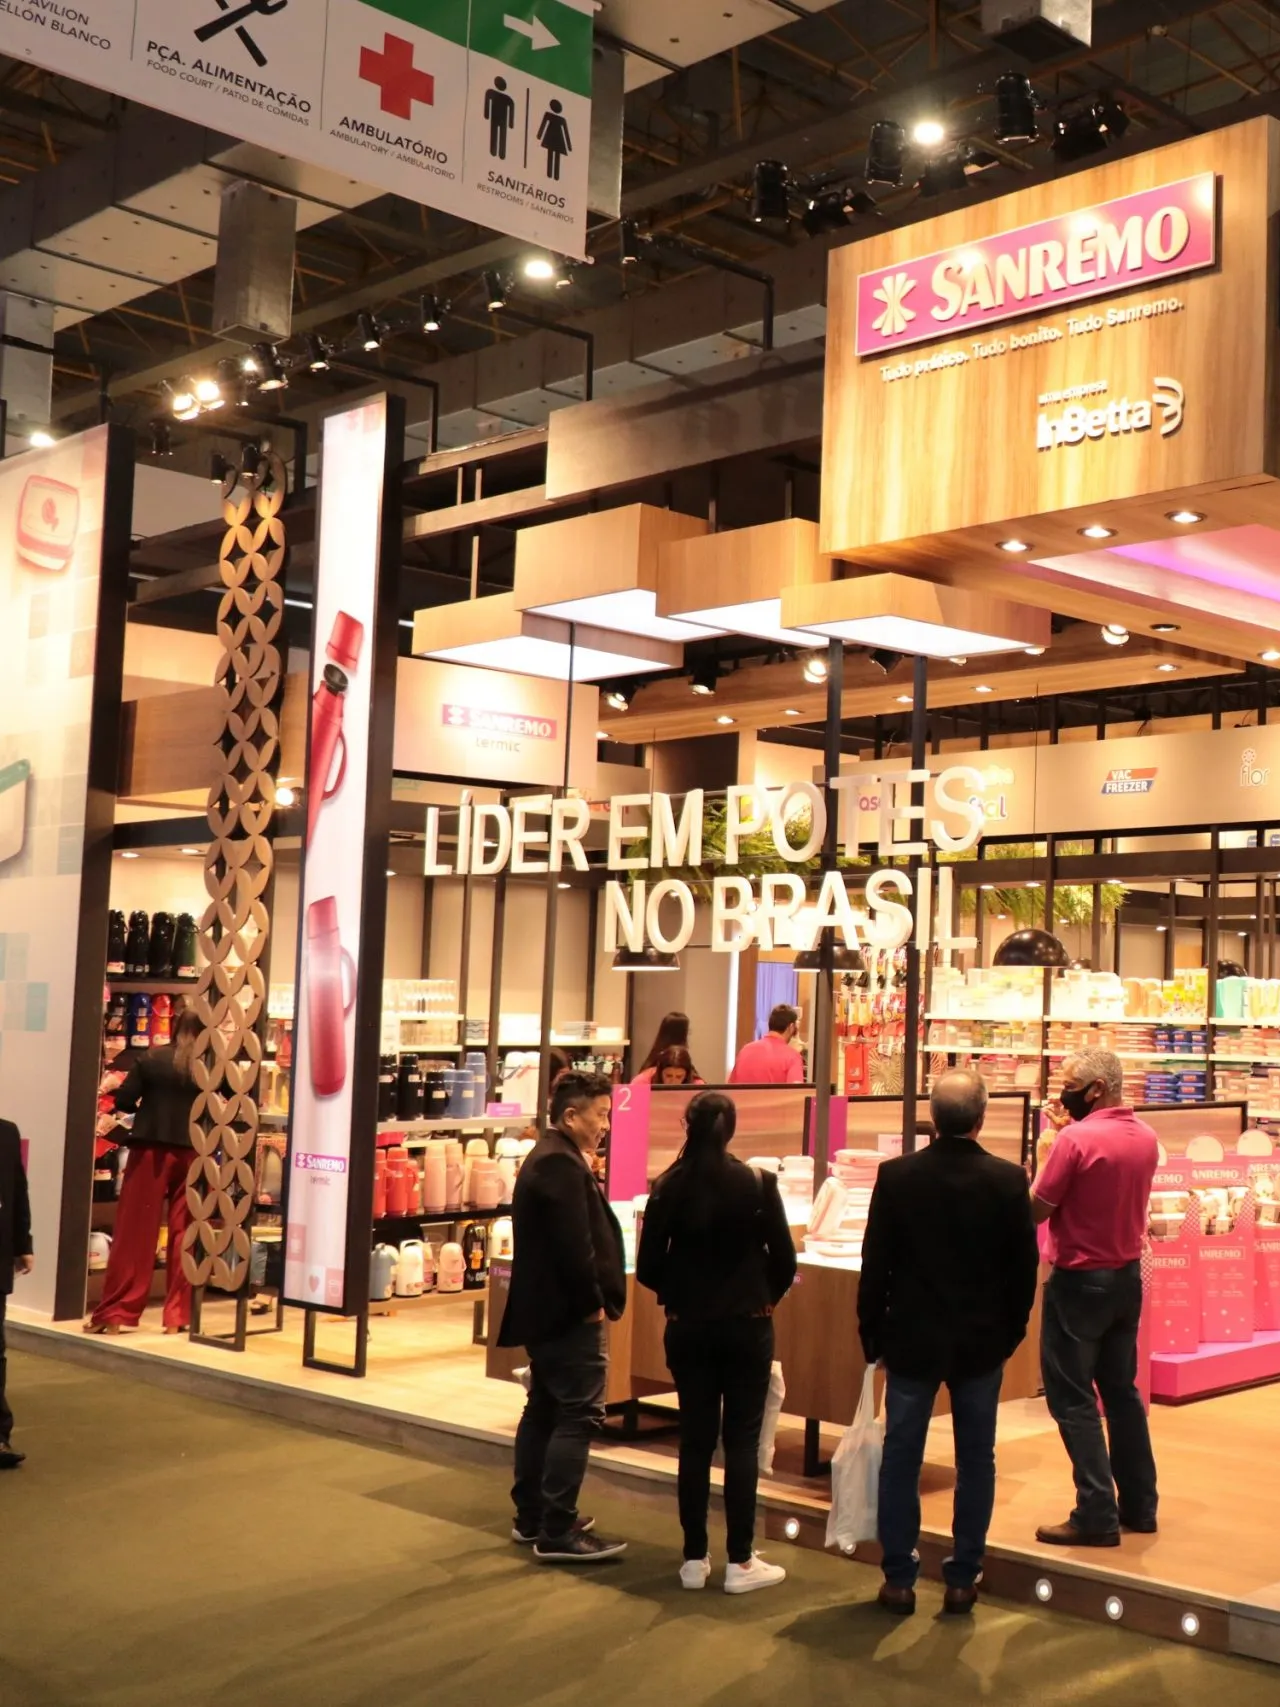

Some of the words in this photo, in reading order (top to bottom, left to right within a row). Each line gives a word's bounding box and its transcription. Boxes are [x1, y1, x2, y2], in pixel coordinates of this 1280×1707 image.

[20, 0, 90, 25] AVILION
[51, 19, 111, 50] BLANCO
[146, 40, 187, 65] PÇA.
[192, 59, 312, 113] ALIMENTAÇÃO
[147, 59, 177, 76] FOOD
[179, 71, 213, 90] COURT
[251, 98, 264, 109] DE
[266, 104, 309, 127] COMIDAS
[330, 129, 390, 156] AMBULATORY
[396, 153, 455, 180] AMBULATORIO
[339, 116, 448, 164] AMBULATÓRIO
[477, 182, 524, 207] RESTROOMS
[487, 170, 566, 209] SANITÁRIOS
[931, 206, 1190, 321] SANREMO
[880, 364, 911, 383] Tudo
[972, 340, 1006, 360] Tudo
[1010, 323, 1064, 351] bonito.
[1067, 312, 1105, 338] Tudo
[1106, 297, 1185, 327] Sanremo.
[1106, 780, 1148, 794] FREEZER
[1111, 769, 1132, 781] VAC
[424, 789, 590, 876] LÍDER
[607, 788, 704, 871] EM
[725, 765, 986, 866] POTES
[604, 878, 696, 953] NO
[712, 866, 978, 953] BRASIL
[618, 1087, 632, 1111] 2
[306, 1154, 345, 1173] SANREMO
[1152, 1173, 1183, 1185] REMO
[1192, 1169, 1239, 1180] ANREMO
[1200, 1249, 1241, 1260] ANREMO
